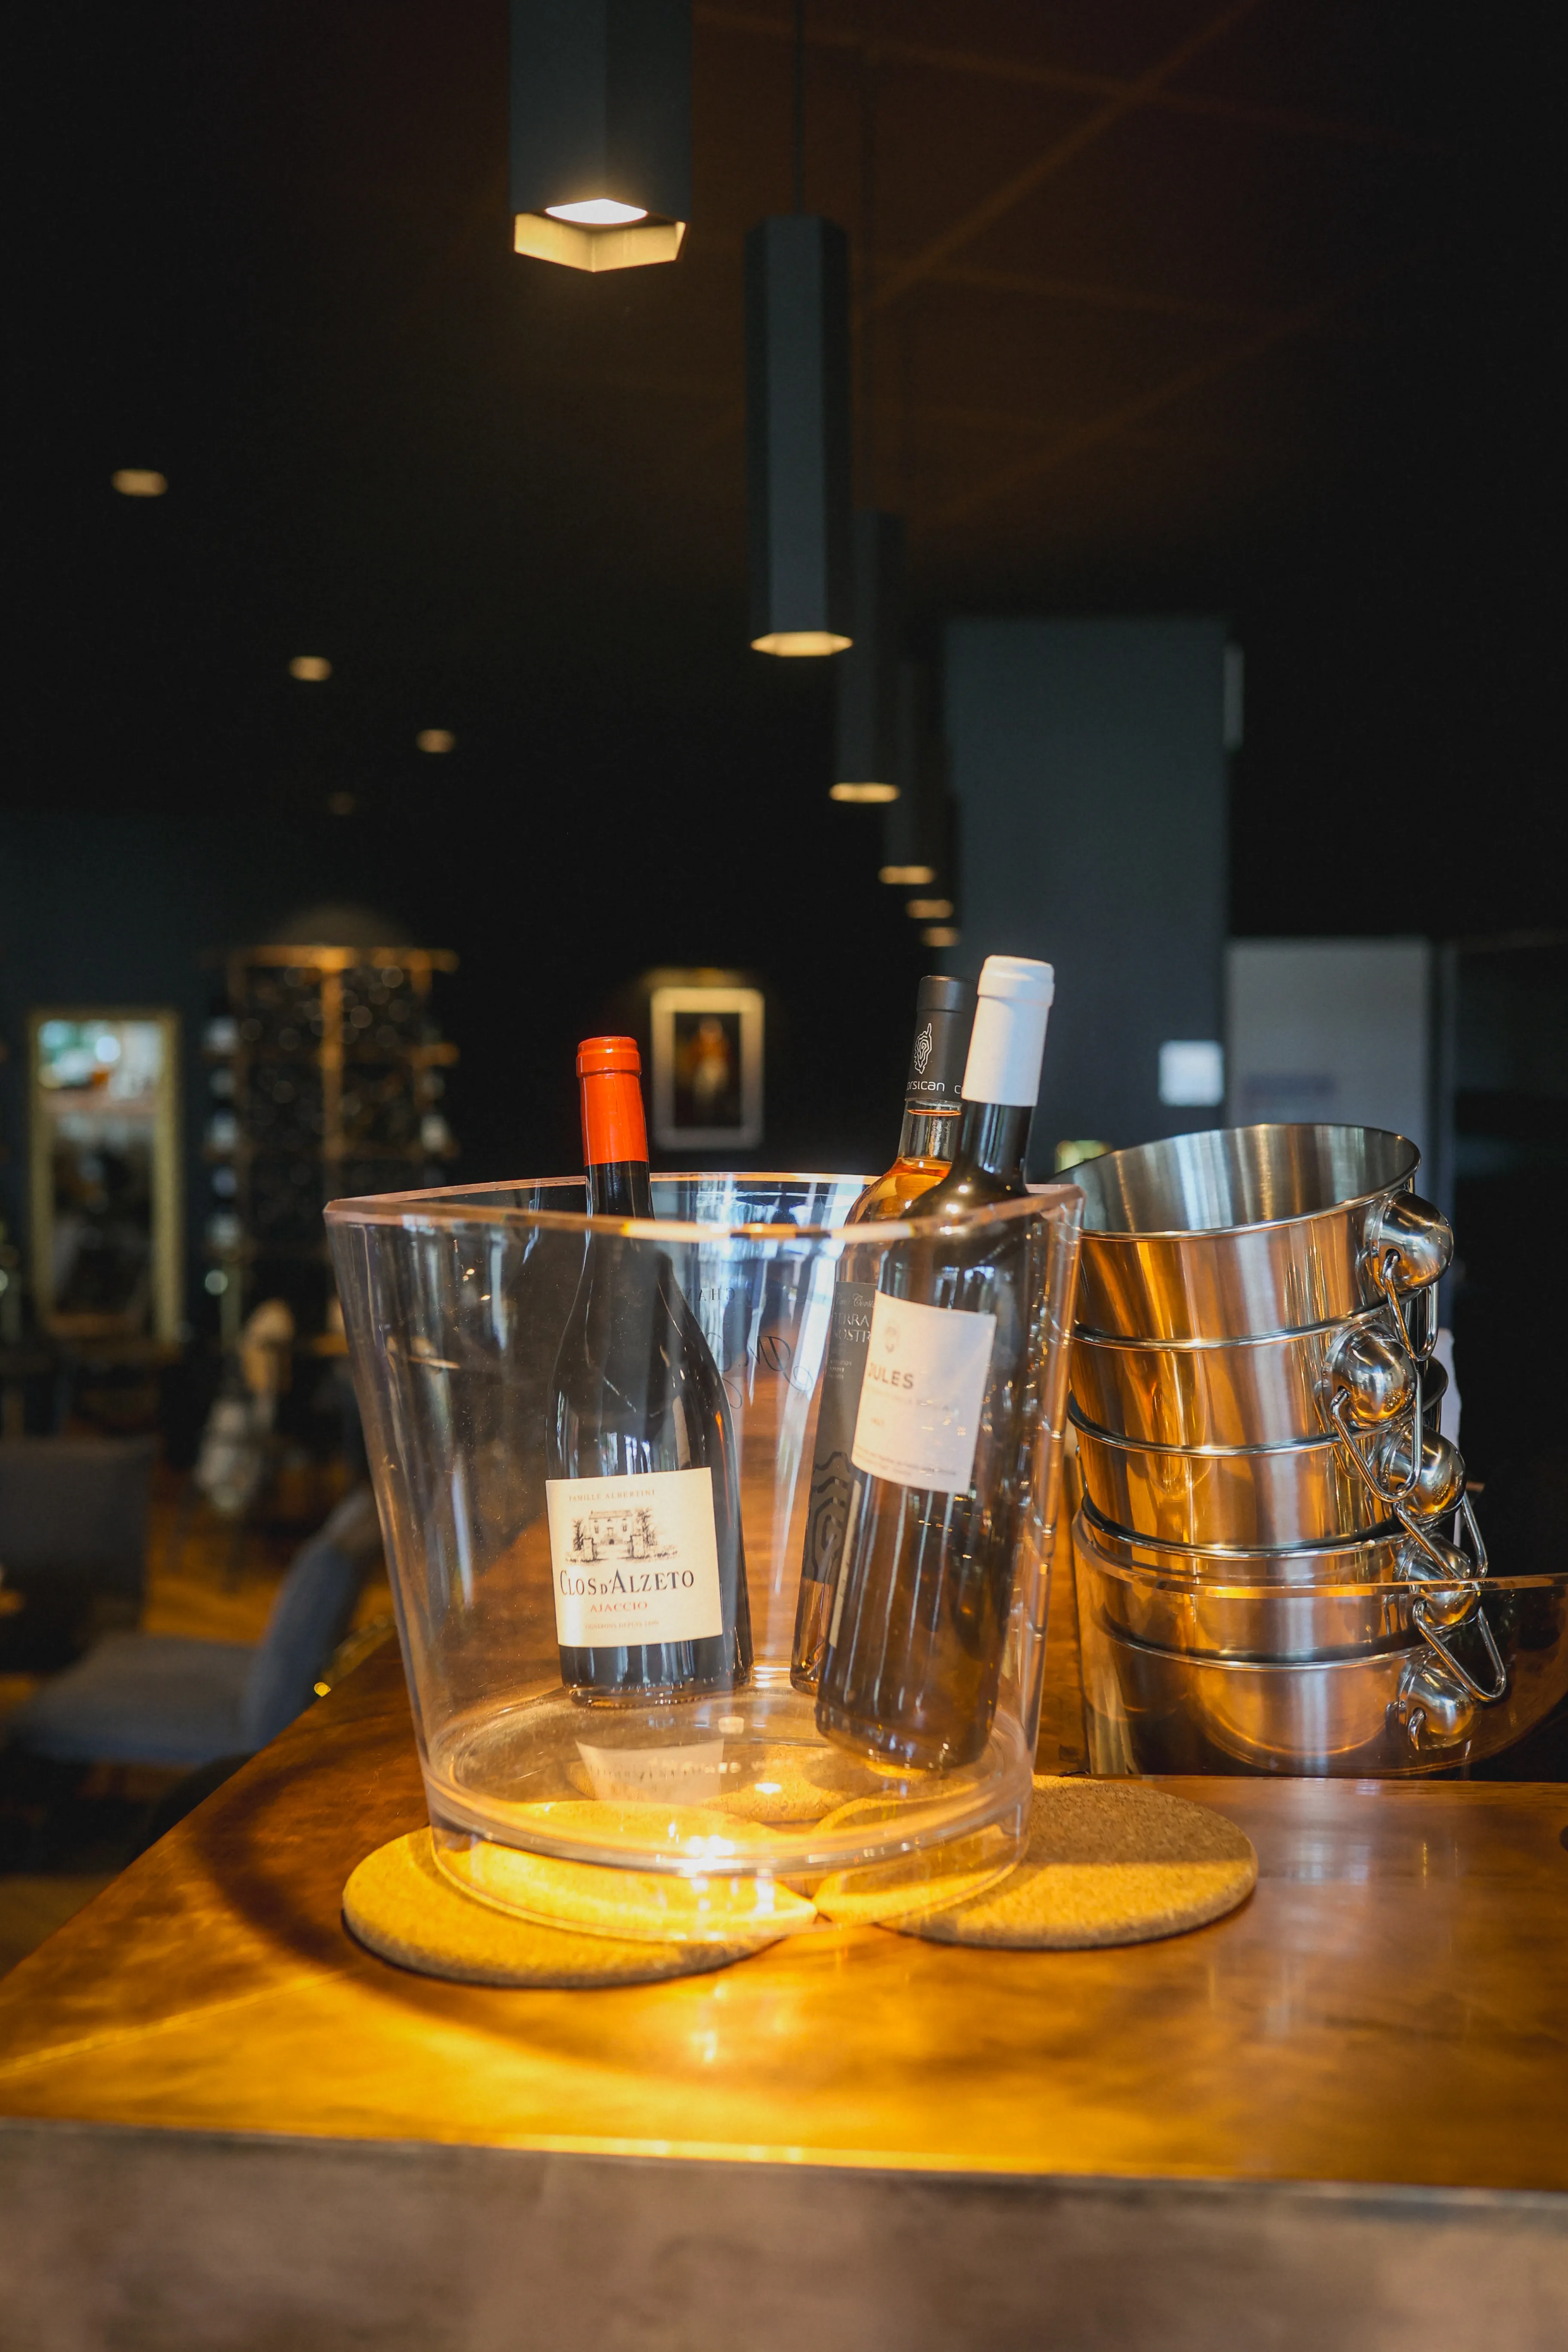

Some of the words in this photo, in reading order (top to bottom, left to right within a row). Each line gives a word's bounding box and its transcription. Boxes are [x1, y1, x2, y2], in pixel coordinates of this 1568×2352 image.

[906, 1081, 945, 1092] orsican
[867, 1362, 914, 1390] JULES
[569, 1493, 601, 1501] FAMILLE
[605, 1489, 655, 1499] ALBERTINI
[560, 1569, 597, 1596] CLOS
[590, 1601, 648, 1613] AJACCIO
